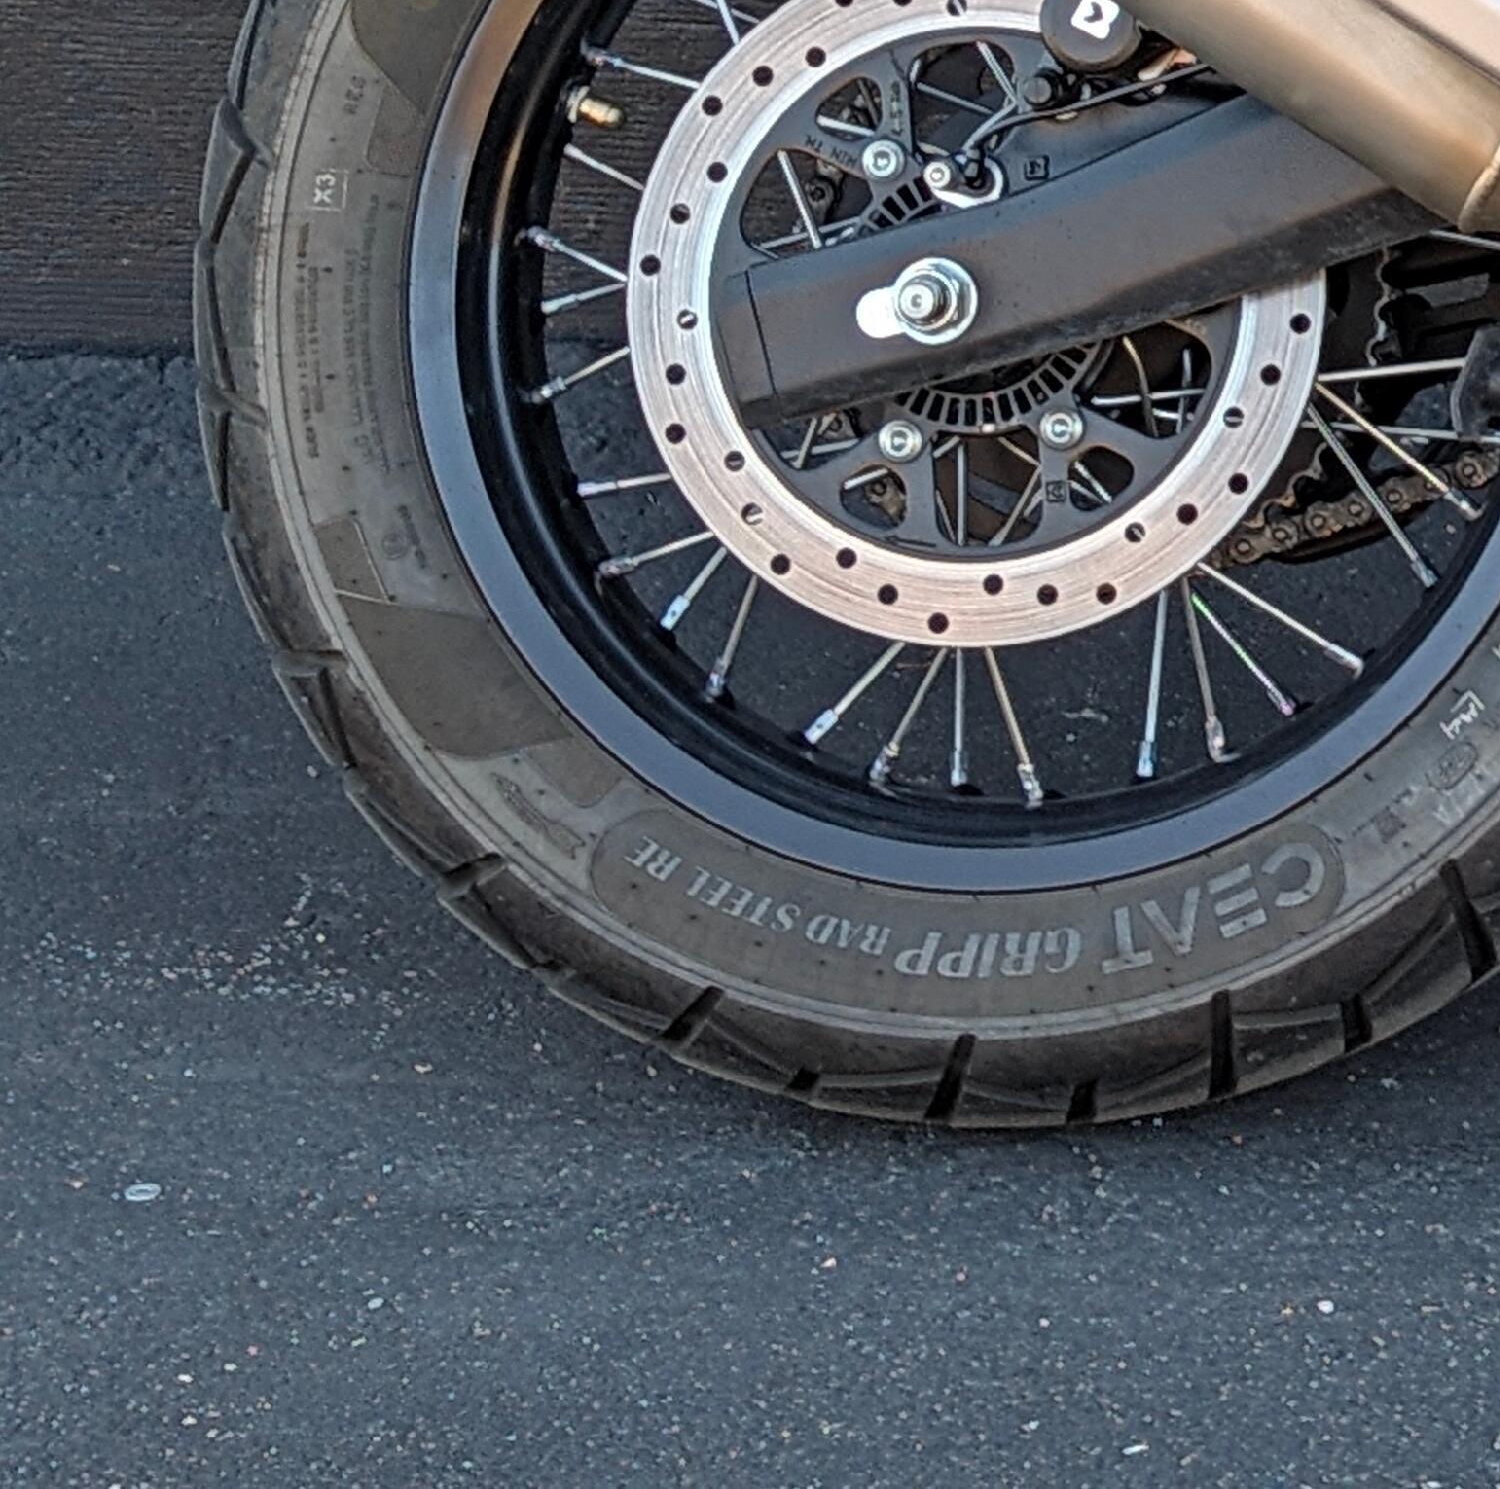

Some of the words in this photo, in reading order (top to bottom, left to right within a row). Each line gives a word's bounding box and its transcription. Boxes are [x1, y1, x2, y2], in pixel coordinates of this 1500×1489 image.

[625, 834, 684, 884] RE
[685, 869, 801, 940] STEEL
[1102, 845, 1326, 975] CEAT
[804, 913, 892, 956] RAD
[893, 921, 1083, 980] GRIPP
